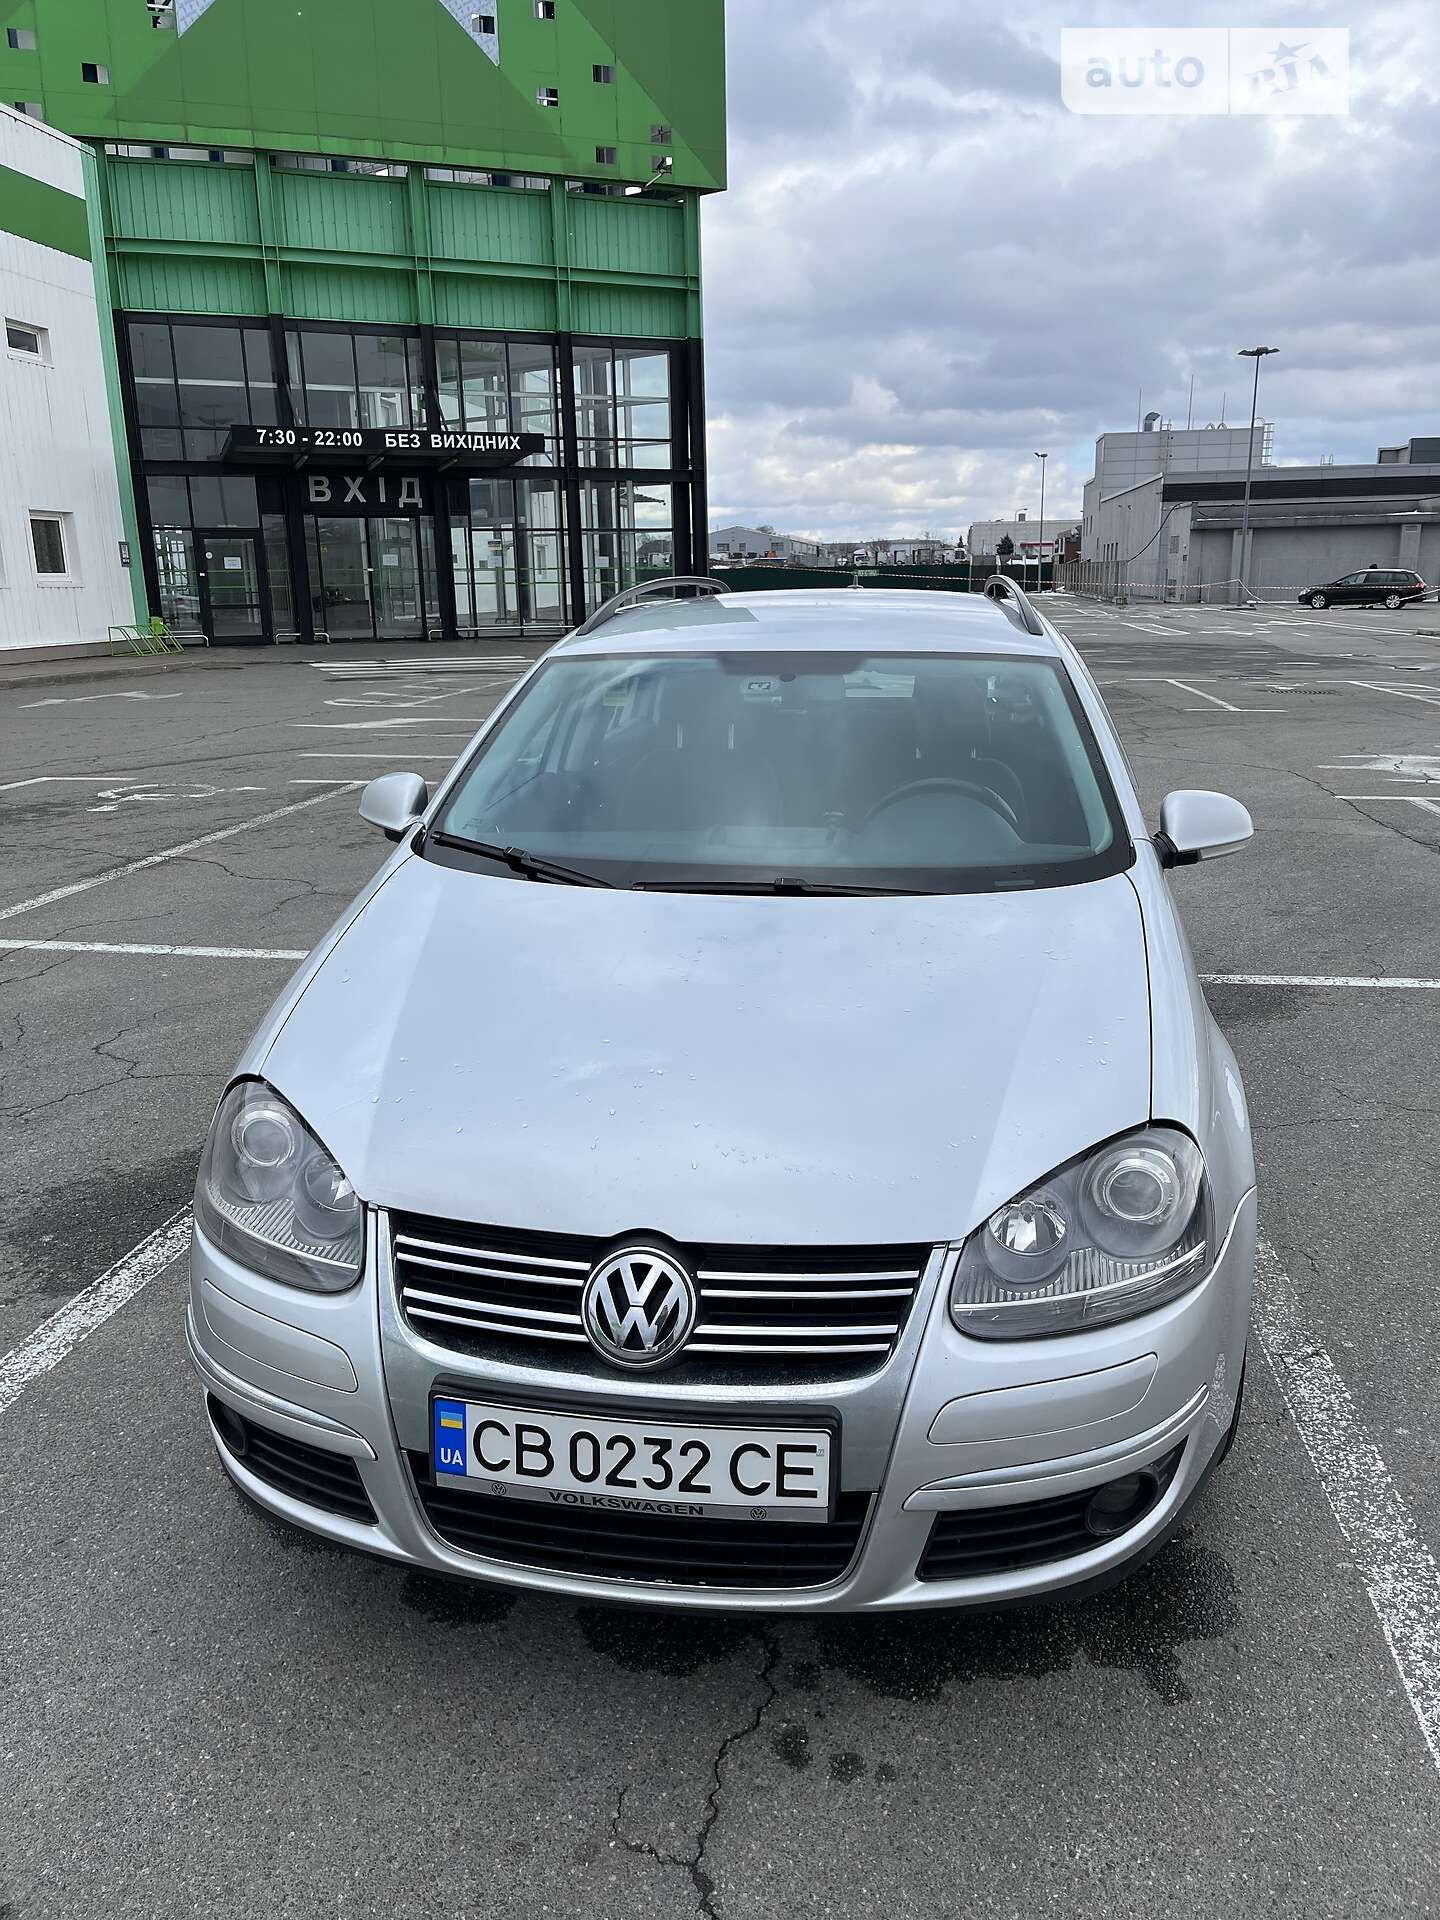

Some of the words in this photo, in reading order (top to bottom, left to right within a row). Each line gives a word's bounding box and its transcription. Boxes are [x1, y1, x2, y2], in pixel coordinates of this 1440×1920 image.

[256, 429, 296, 445] 7:30
[314, 431, 362, 447] 22:00
[385, 433, 421, 448] БЕЗ
[431, 433, 521, 451] ВИХІДНИХ
[308, 475, 423, 508] ВХІД
[440, 1447, 463, 1466] UA
[472, 1420, 555, 1478] CB
[569, 1431, 712, 1494] 0232
[729, 1443, 818, 1499] CE
[548, 1490, 704, 1516] VOLKSWAGEN
